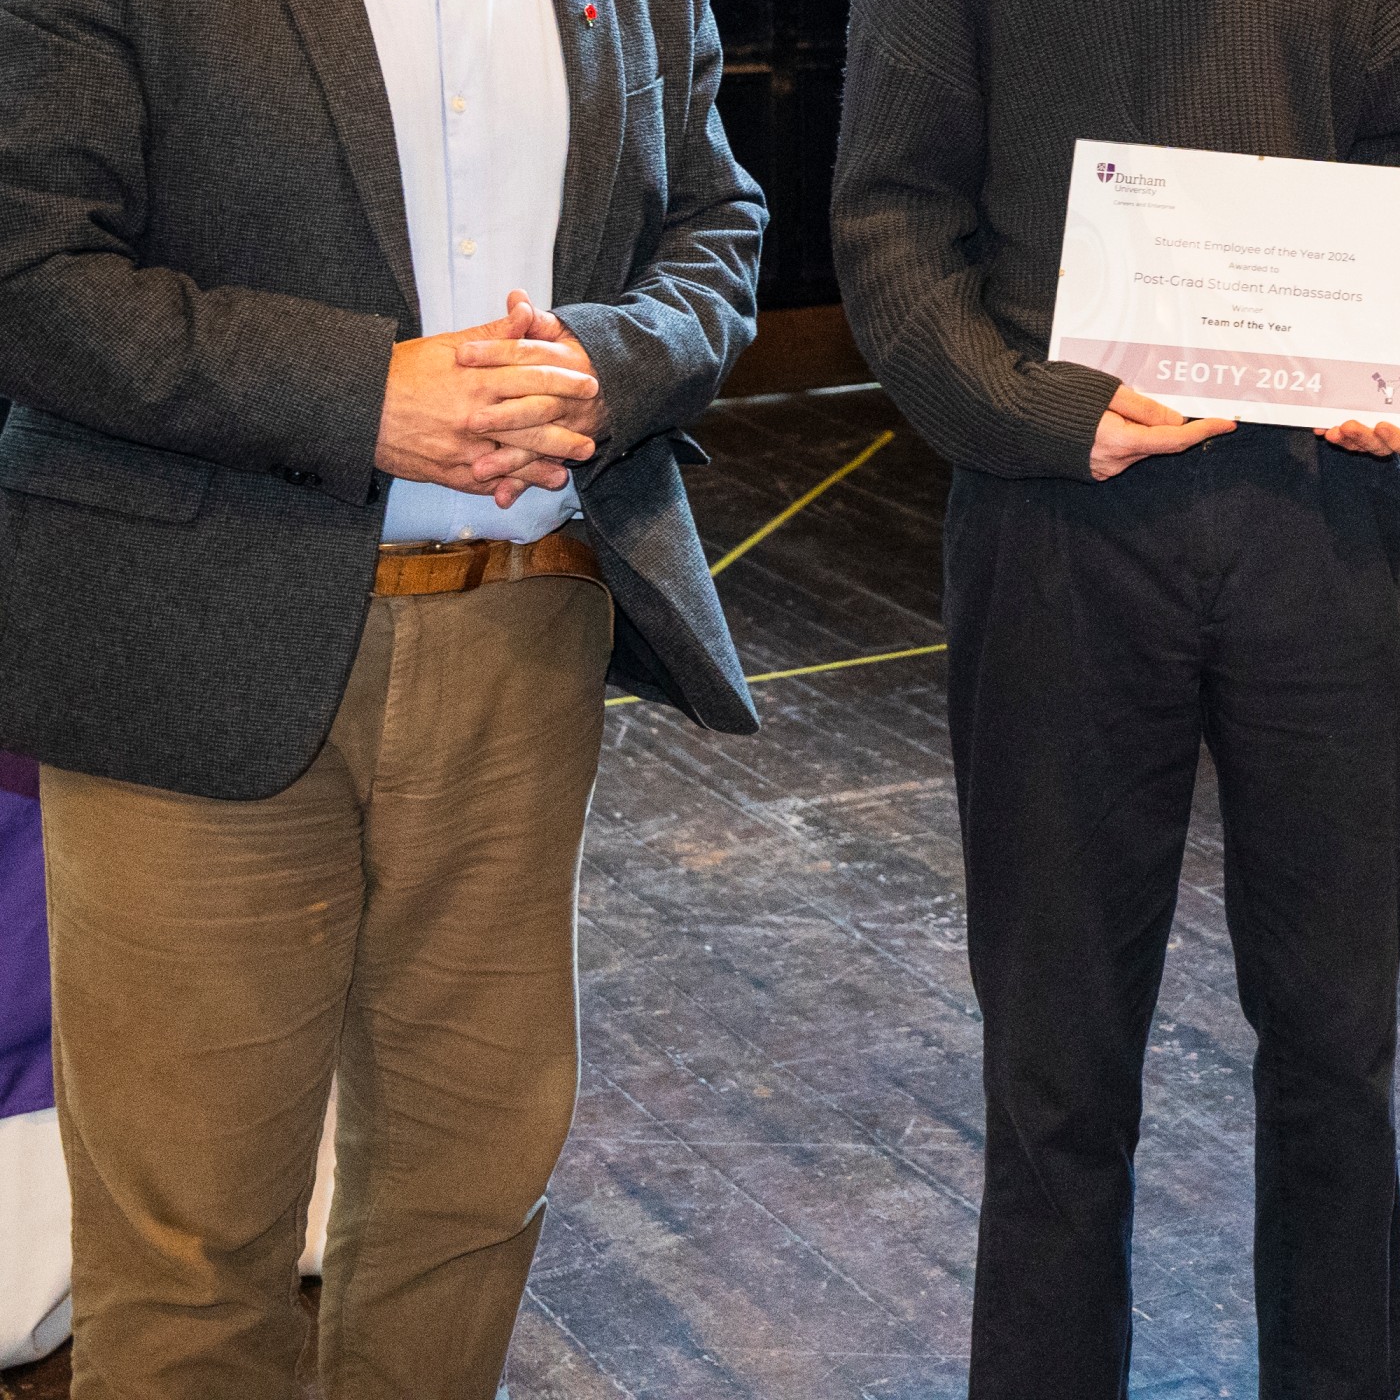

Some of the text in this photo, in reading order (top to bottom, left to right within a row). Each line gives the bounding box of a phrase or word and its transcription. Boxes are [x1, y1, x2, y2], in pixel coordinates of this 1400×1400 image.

[1116, 173, 1165, 187] Durham
[1115, 187, 1156, 196] University
[1155, 237, 1355, 262] Student Employee of the Year 2024
[1229, 263, 1267, 272] Awarded
[1134, 272, 1362, 302] Post-Grad Student Ambassadors
[1232, 305, 1263, 313] Winner
[1202, 317, 1229, 326] Team
[1269, 323, 1291, 331] Year
[1157, 360, 1321, 392] SEOTY 2024
